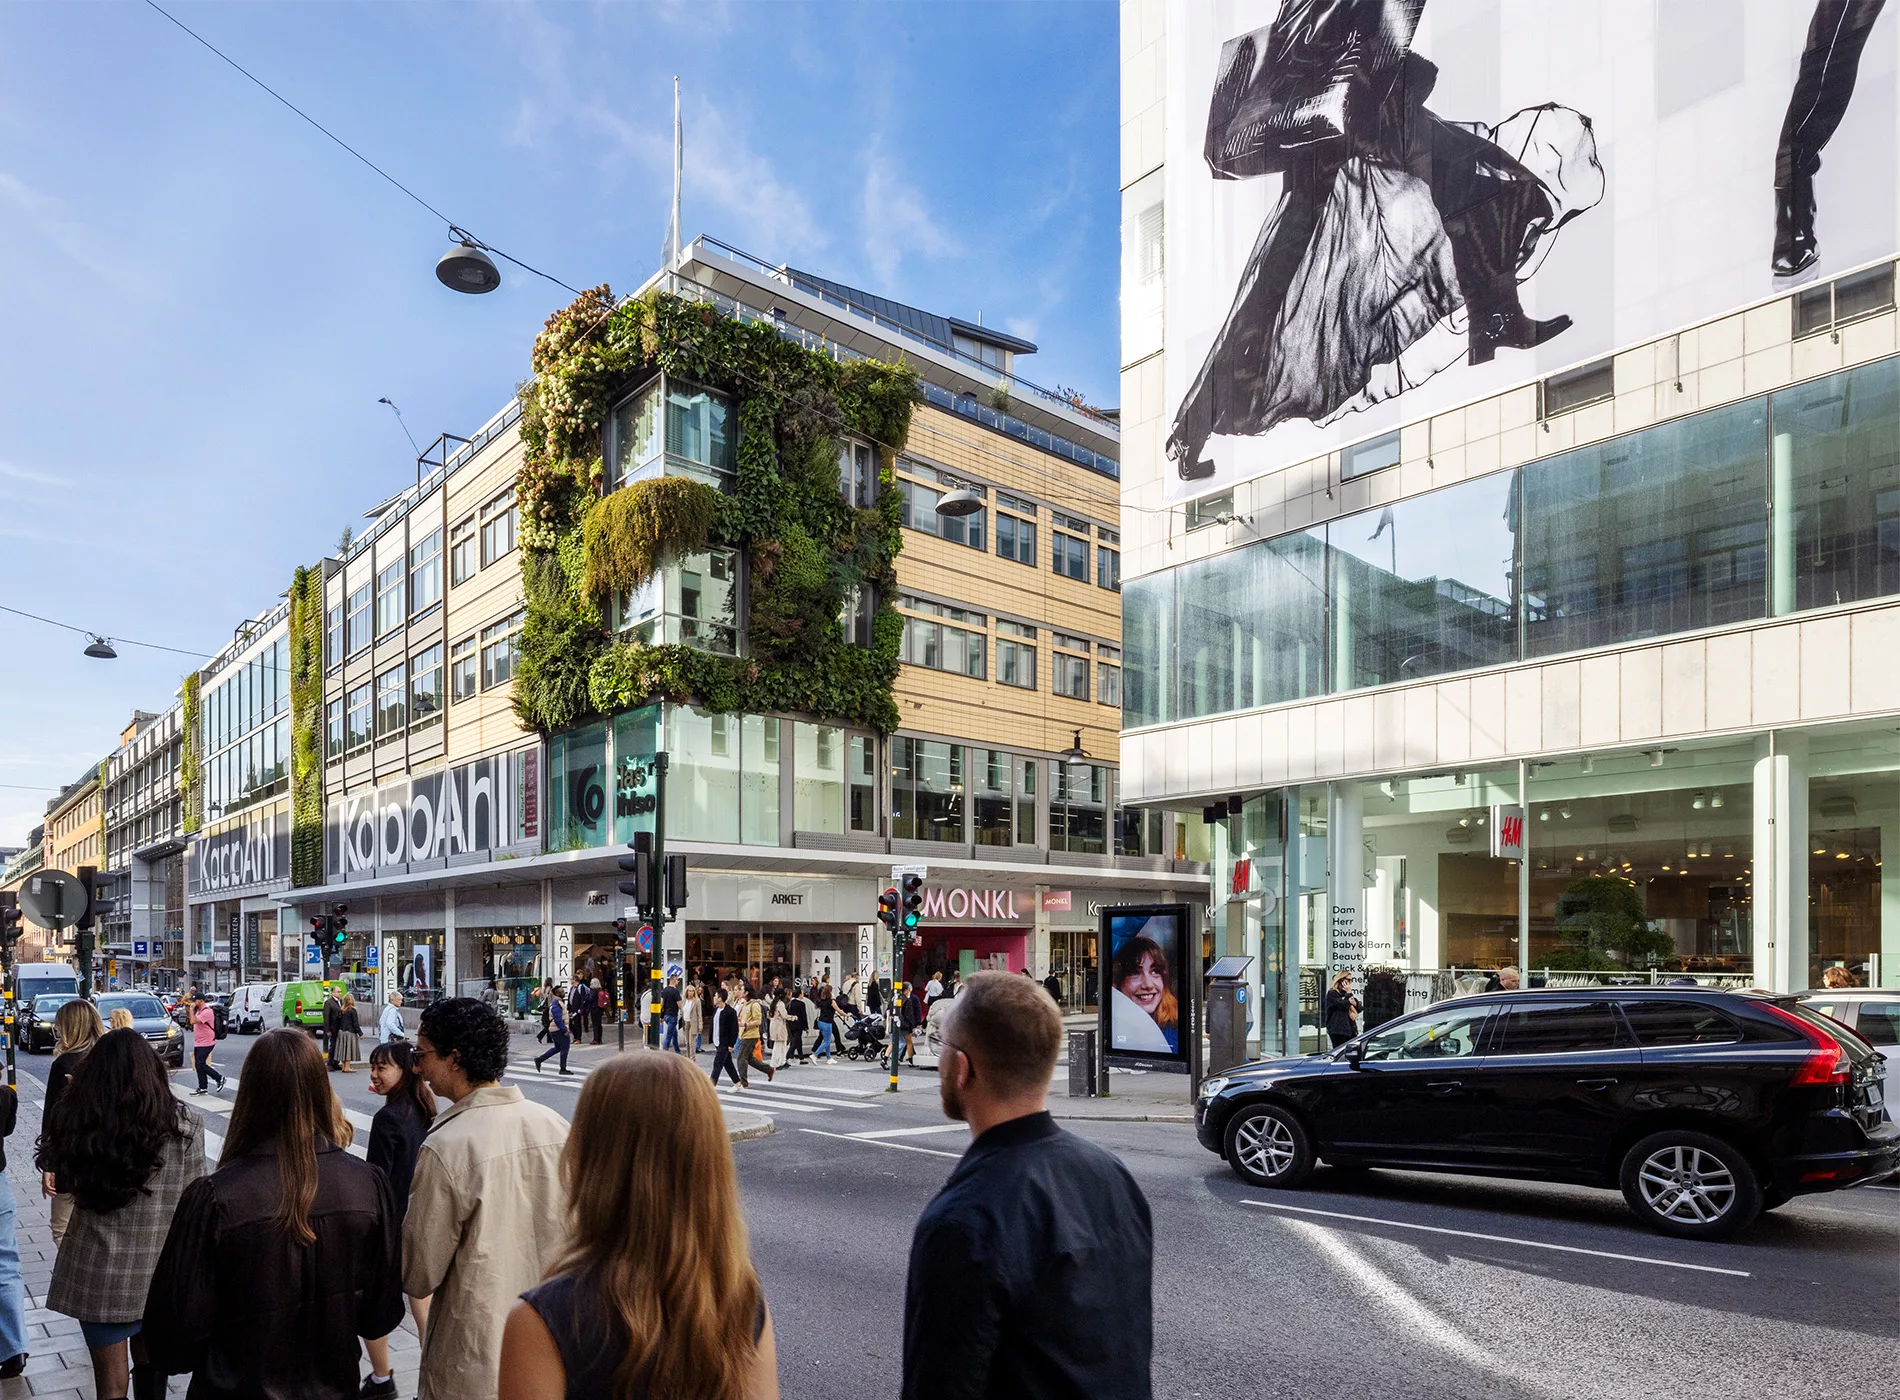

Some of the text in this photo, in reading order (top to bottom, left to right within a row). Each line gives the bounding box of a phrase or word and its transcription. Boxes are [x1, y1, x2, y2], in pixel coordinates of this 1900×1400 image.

[617, 764, 647, 790] las
[339, 753, 508, 873] KappAhl
[1501, 816, 1523, 848] H&M
[200, 815, 274, 891] KappAhl
[588, 894, 609, 905] ARKET
[771, 893, 803, 905] ARKET
[1332, 905, 1355, 914] Dam
[1332, 917, 1354, 926] Herr
[1332, 929, 1368, 938] Divided
[1332, 940, 1391, 950] Baby & Barn
[307, 951, 314, 962] P
[369, 947, 376, 957] P
[1332, 952, 1367, 962] Beauty
[387, 940, 395, 994] ARKE
[559, 928, 569, 1001] ARKE
[1332, 963, 1356, 972] Click
[794, 977, 812, 987] SAL
[1239, 990, 1245, 1001] P
